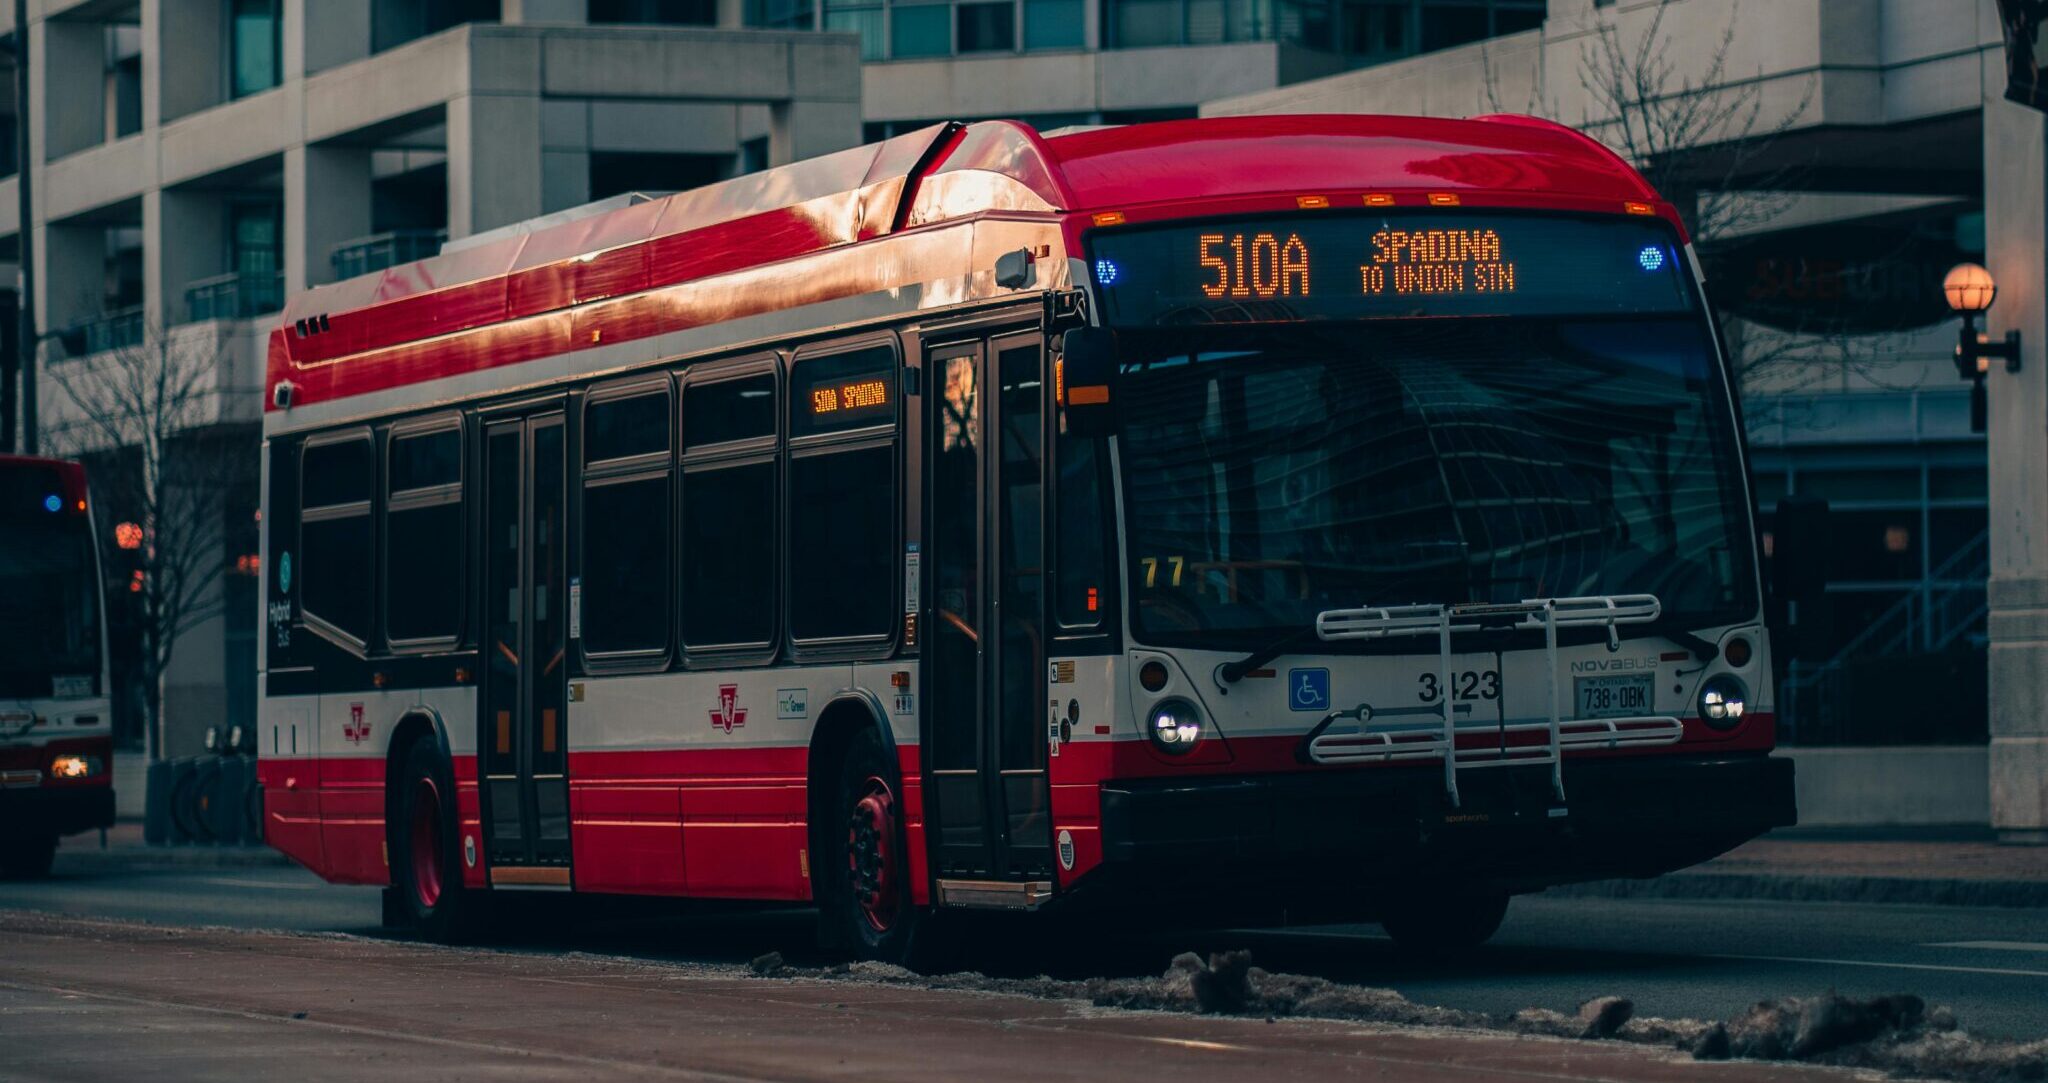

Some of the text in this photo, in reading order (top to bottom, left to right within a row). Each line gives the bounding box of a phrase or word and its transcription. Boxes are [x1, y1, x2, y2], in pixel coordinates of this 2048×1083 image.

[1372, 230, 1500, 262] SPADINA
[1200, 233, 1309, 296] 510A
[1360, 263, 1514, 293] TO UNION STN
[1746, 256, 1938, 303] SUBWA
[814, 381, 886, 413] 510A SPADINA
[269, 599, 291, 628] Hybrid
[791, 699, 805, 712] Green
